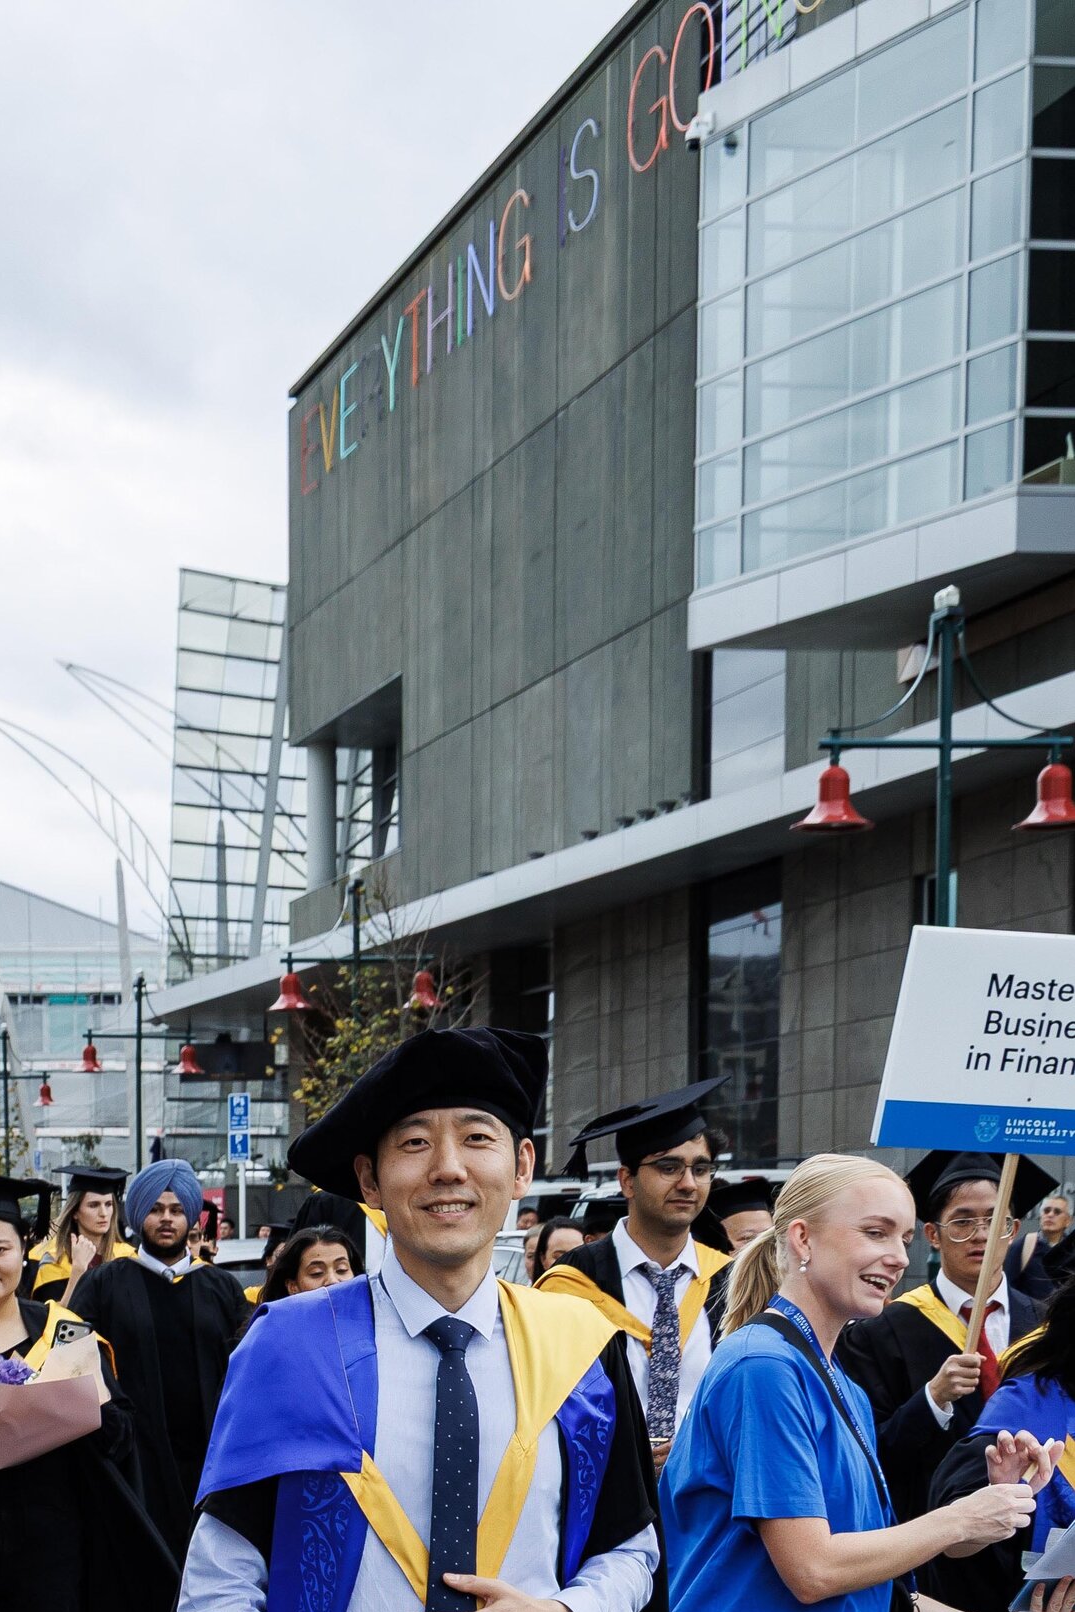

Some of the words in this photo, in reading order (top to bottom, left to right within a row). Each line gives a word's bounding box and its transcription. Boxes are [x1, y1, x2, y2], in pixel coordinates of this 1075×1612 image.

[301, 189, 533, 496] EVERYTHING
[558, 118, 601, 249] IS
[965, 1045, 991, 1071] in
[1004, 1127, 1075, 1138] UNIVERSITY
[1006, 1118, 1057, 1129] LINCOLN
